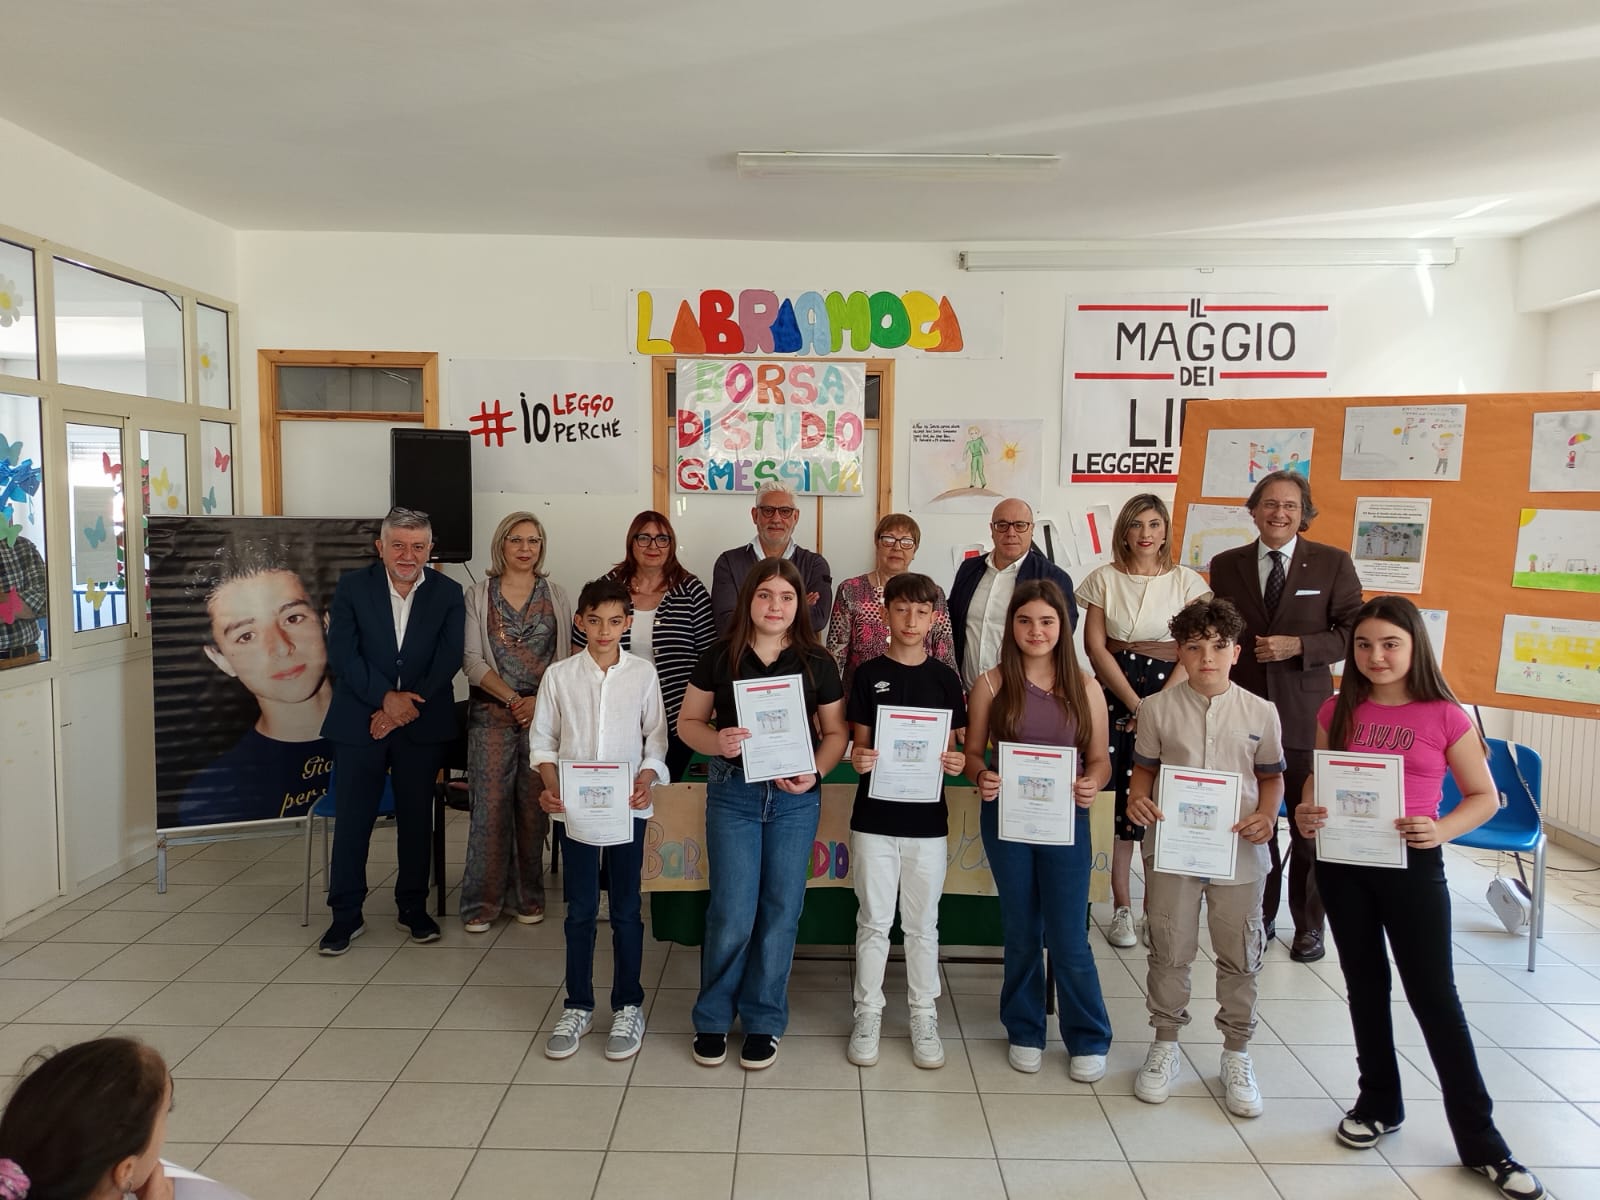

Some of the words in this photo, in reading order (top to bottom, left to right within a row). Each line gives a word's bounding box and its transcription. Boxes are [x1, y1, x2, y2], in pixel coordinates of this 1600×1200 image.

[1190, 298, 1207, 318] IL
[1116, 322, 1296, 362] MAGGIO
[695, 362, 845, 405] BORSA
[1180, 366, 1215, 386] DEI
[552, 392, 614, 419] LEGGO
[553, 417, 622, 444] PERCHÉ
[678, 409, 712, 450] DI
[720, 409, 863, 452] STUDIO
[1130, 398, 1209, 448] LI
[1072, 452, 1174, 474] LEGGERE
[642, 820, 705, 880] BOR
[806, 840, 849, 880] DIO
